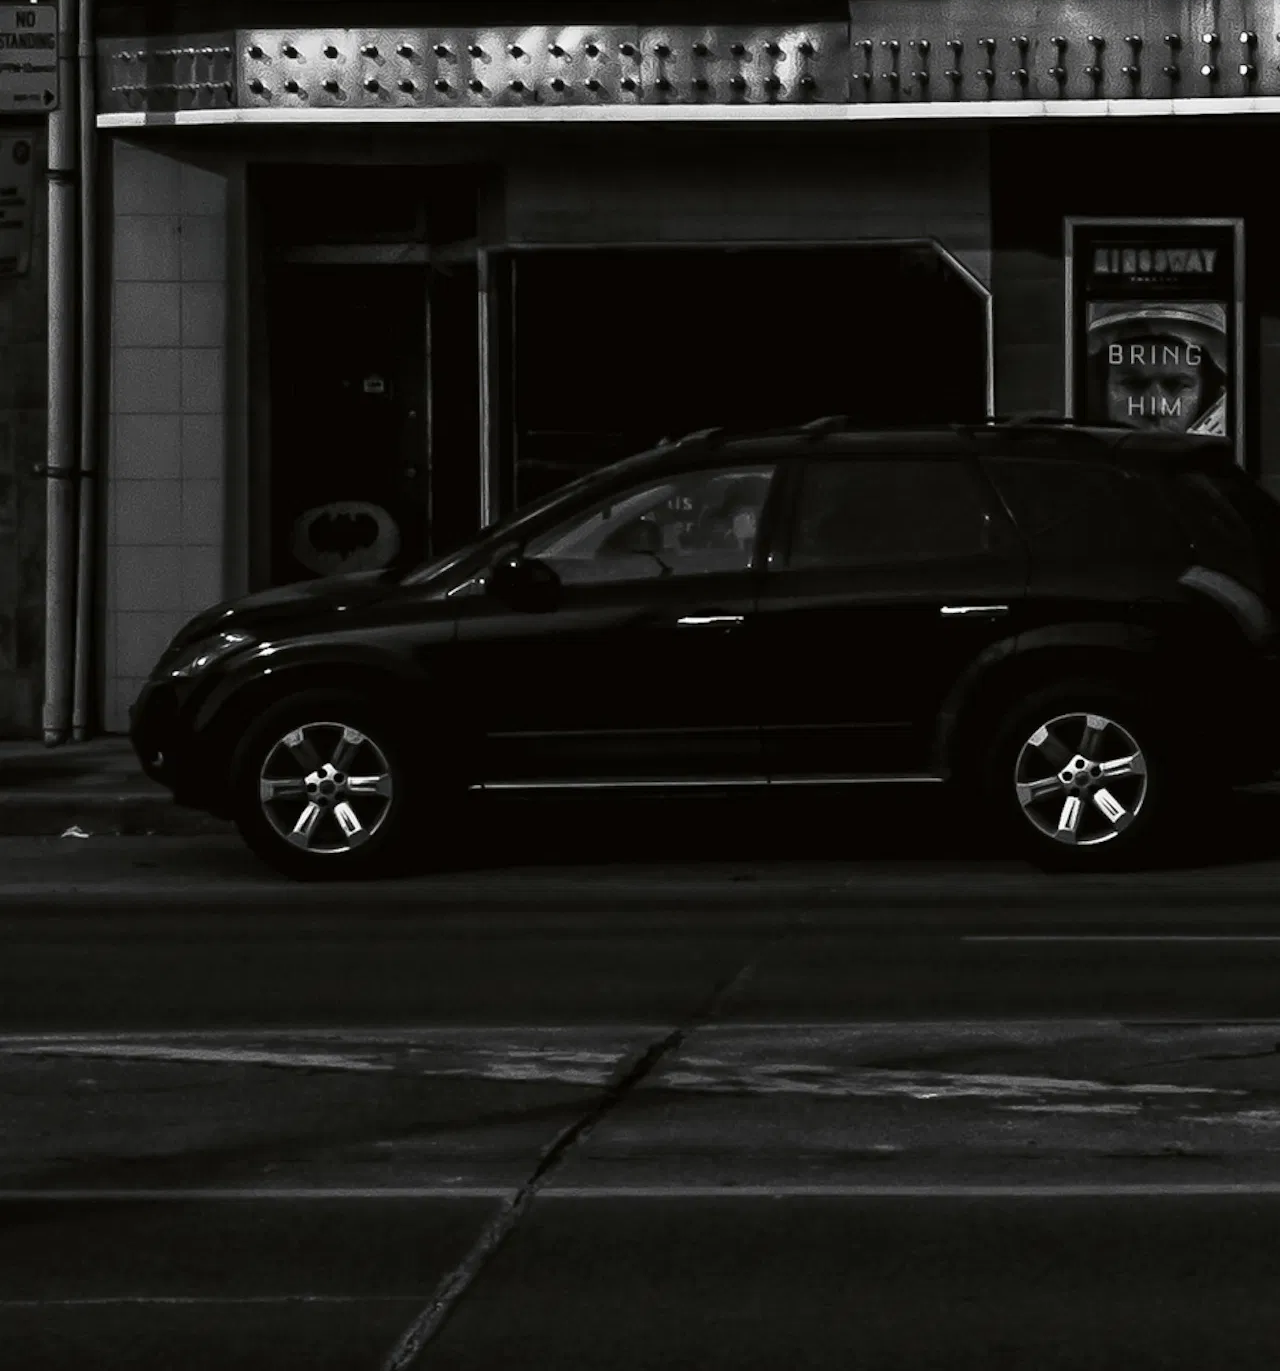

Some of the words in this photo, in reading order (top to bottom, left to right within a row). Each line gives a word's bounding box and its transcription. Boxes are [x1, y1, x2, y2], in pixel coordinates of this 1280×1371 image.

[16, 11, 36, 28] NO
[1108, 344, 1203, 366] BRING
[1127, 395, 1183, 417] HIM
